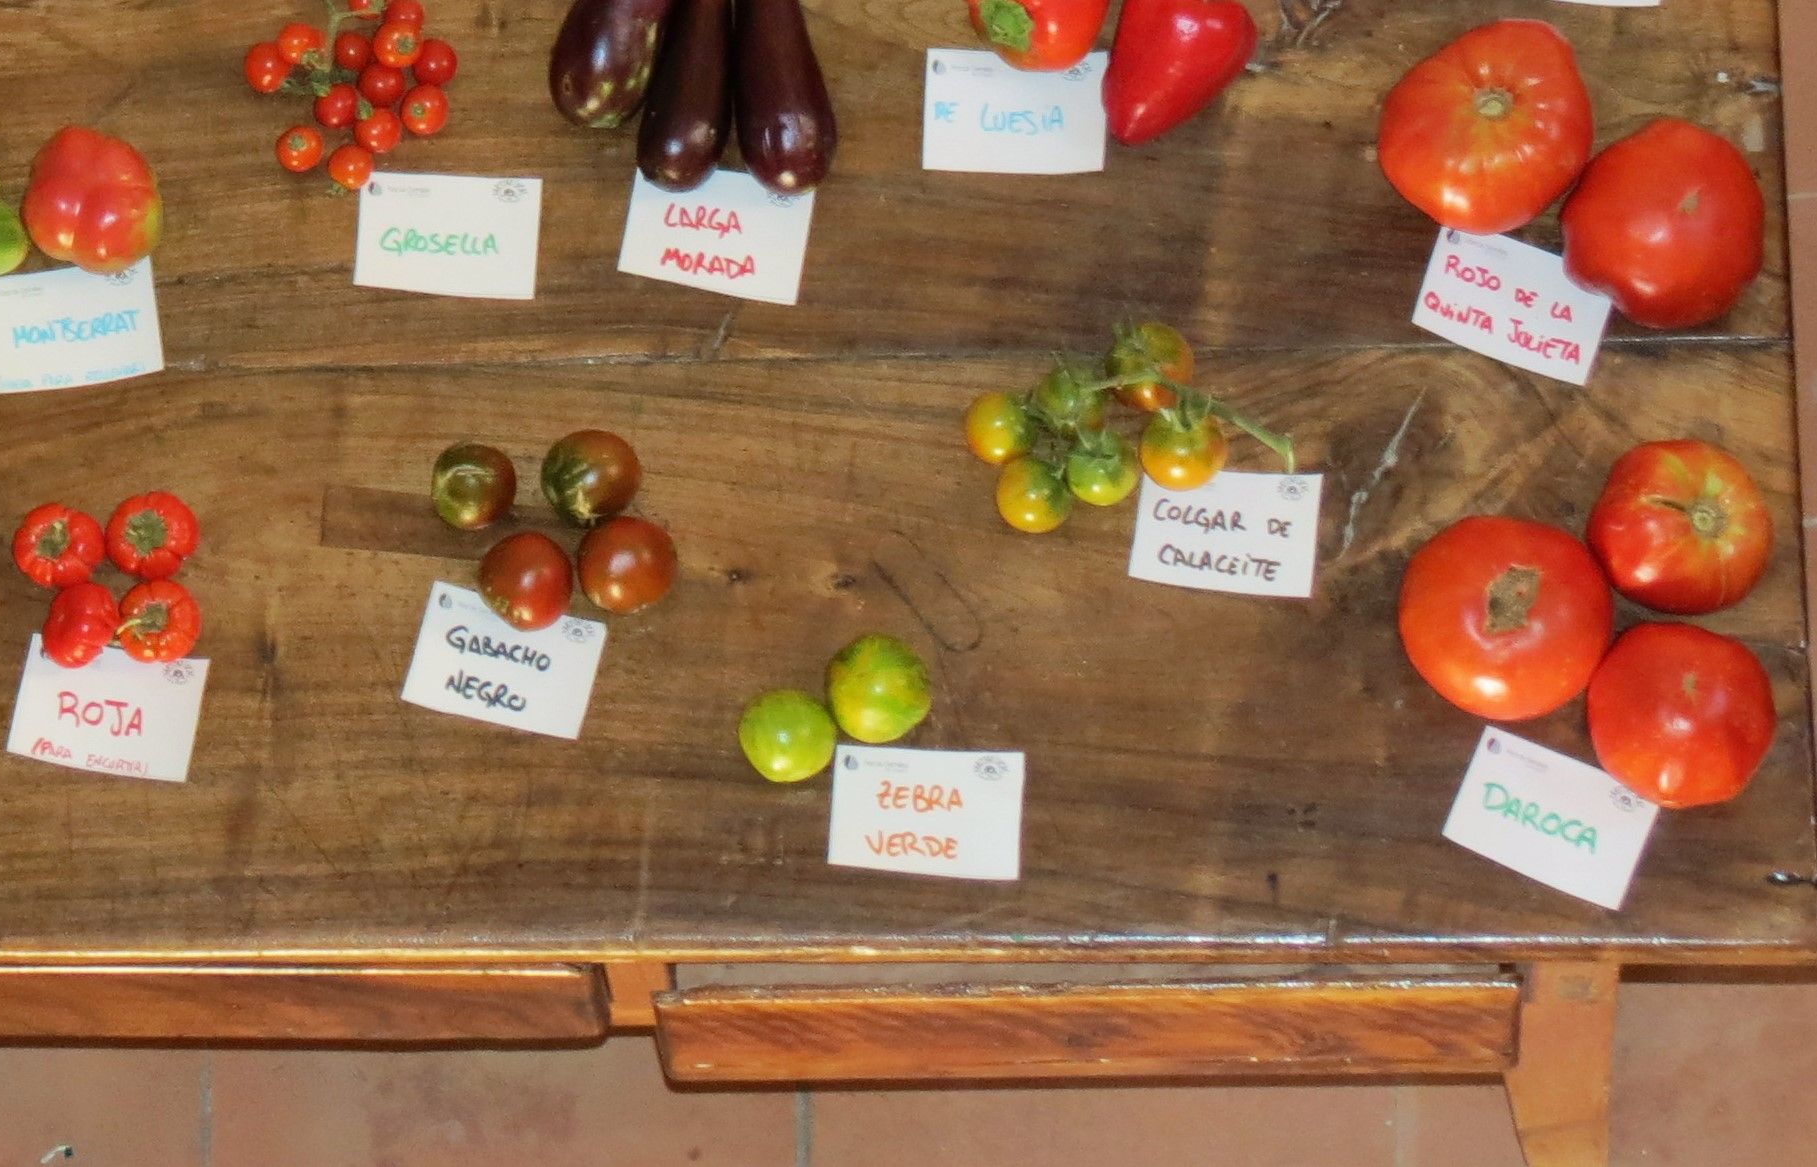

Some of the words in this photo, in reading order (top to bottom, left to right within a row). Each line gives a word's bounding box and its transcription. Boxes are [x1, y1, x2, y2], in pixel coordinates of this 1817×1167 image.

[979, 102, 1066, 136] LUESIA
[663, 203, 743, 236] LARGA
[380, 228, 500, 256] GROSELLA
[660, 247, 756, 277] MORADA
[1445, 254, 1502, 294] ROJO
[1514, 286, 1539, 308] DE
[1550, 299, 1574, 323] LA
[1424, 291, 1495, 334] QUINTA
[1507, 317, 1582, 367] JULIETA
[1153, 497, 1246, 534] COLGAR
[1267, 517, 1293, 539] DE
[1157, 543, 1281, 582] CALACEITE
[446, 626, 552, 672] GABACHO
[445, 669, 526, 713] NEGRO
[57, 690, 143, 737] ROJA
[875, 780, 963, 812] ZEBRA
[1483, 781, 1600, 854] DAROCA
[864, 832, 959, 860] VERDE
